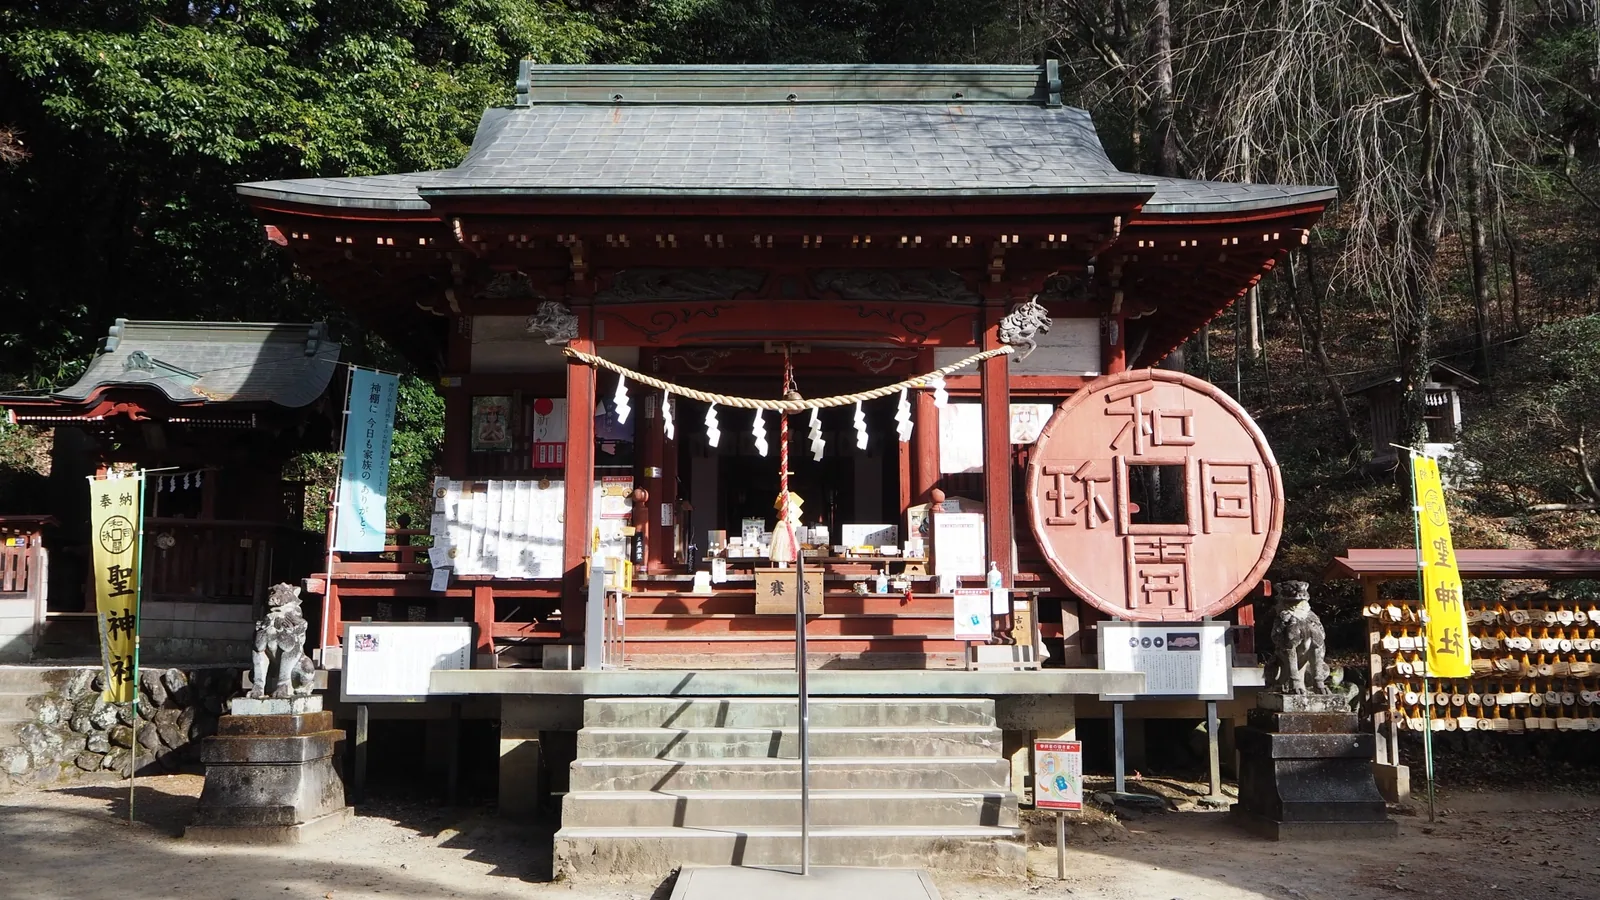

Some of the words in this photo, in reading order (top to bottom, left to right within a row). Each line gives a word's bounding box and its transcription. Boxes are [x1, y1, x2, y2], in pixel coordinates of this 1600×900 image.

[537, 416, 550, 438] 祈り
[100, 492, 132, 509] 奉納
[107, 564, 135, 686] 聖神社
